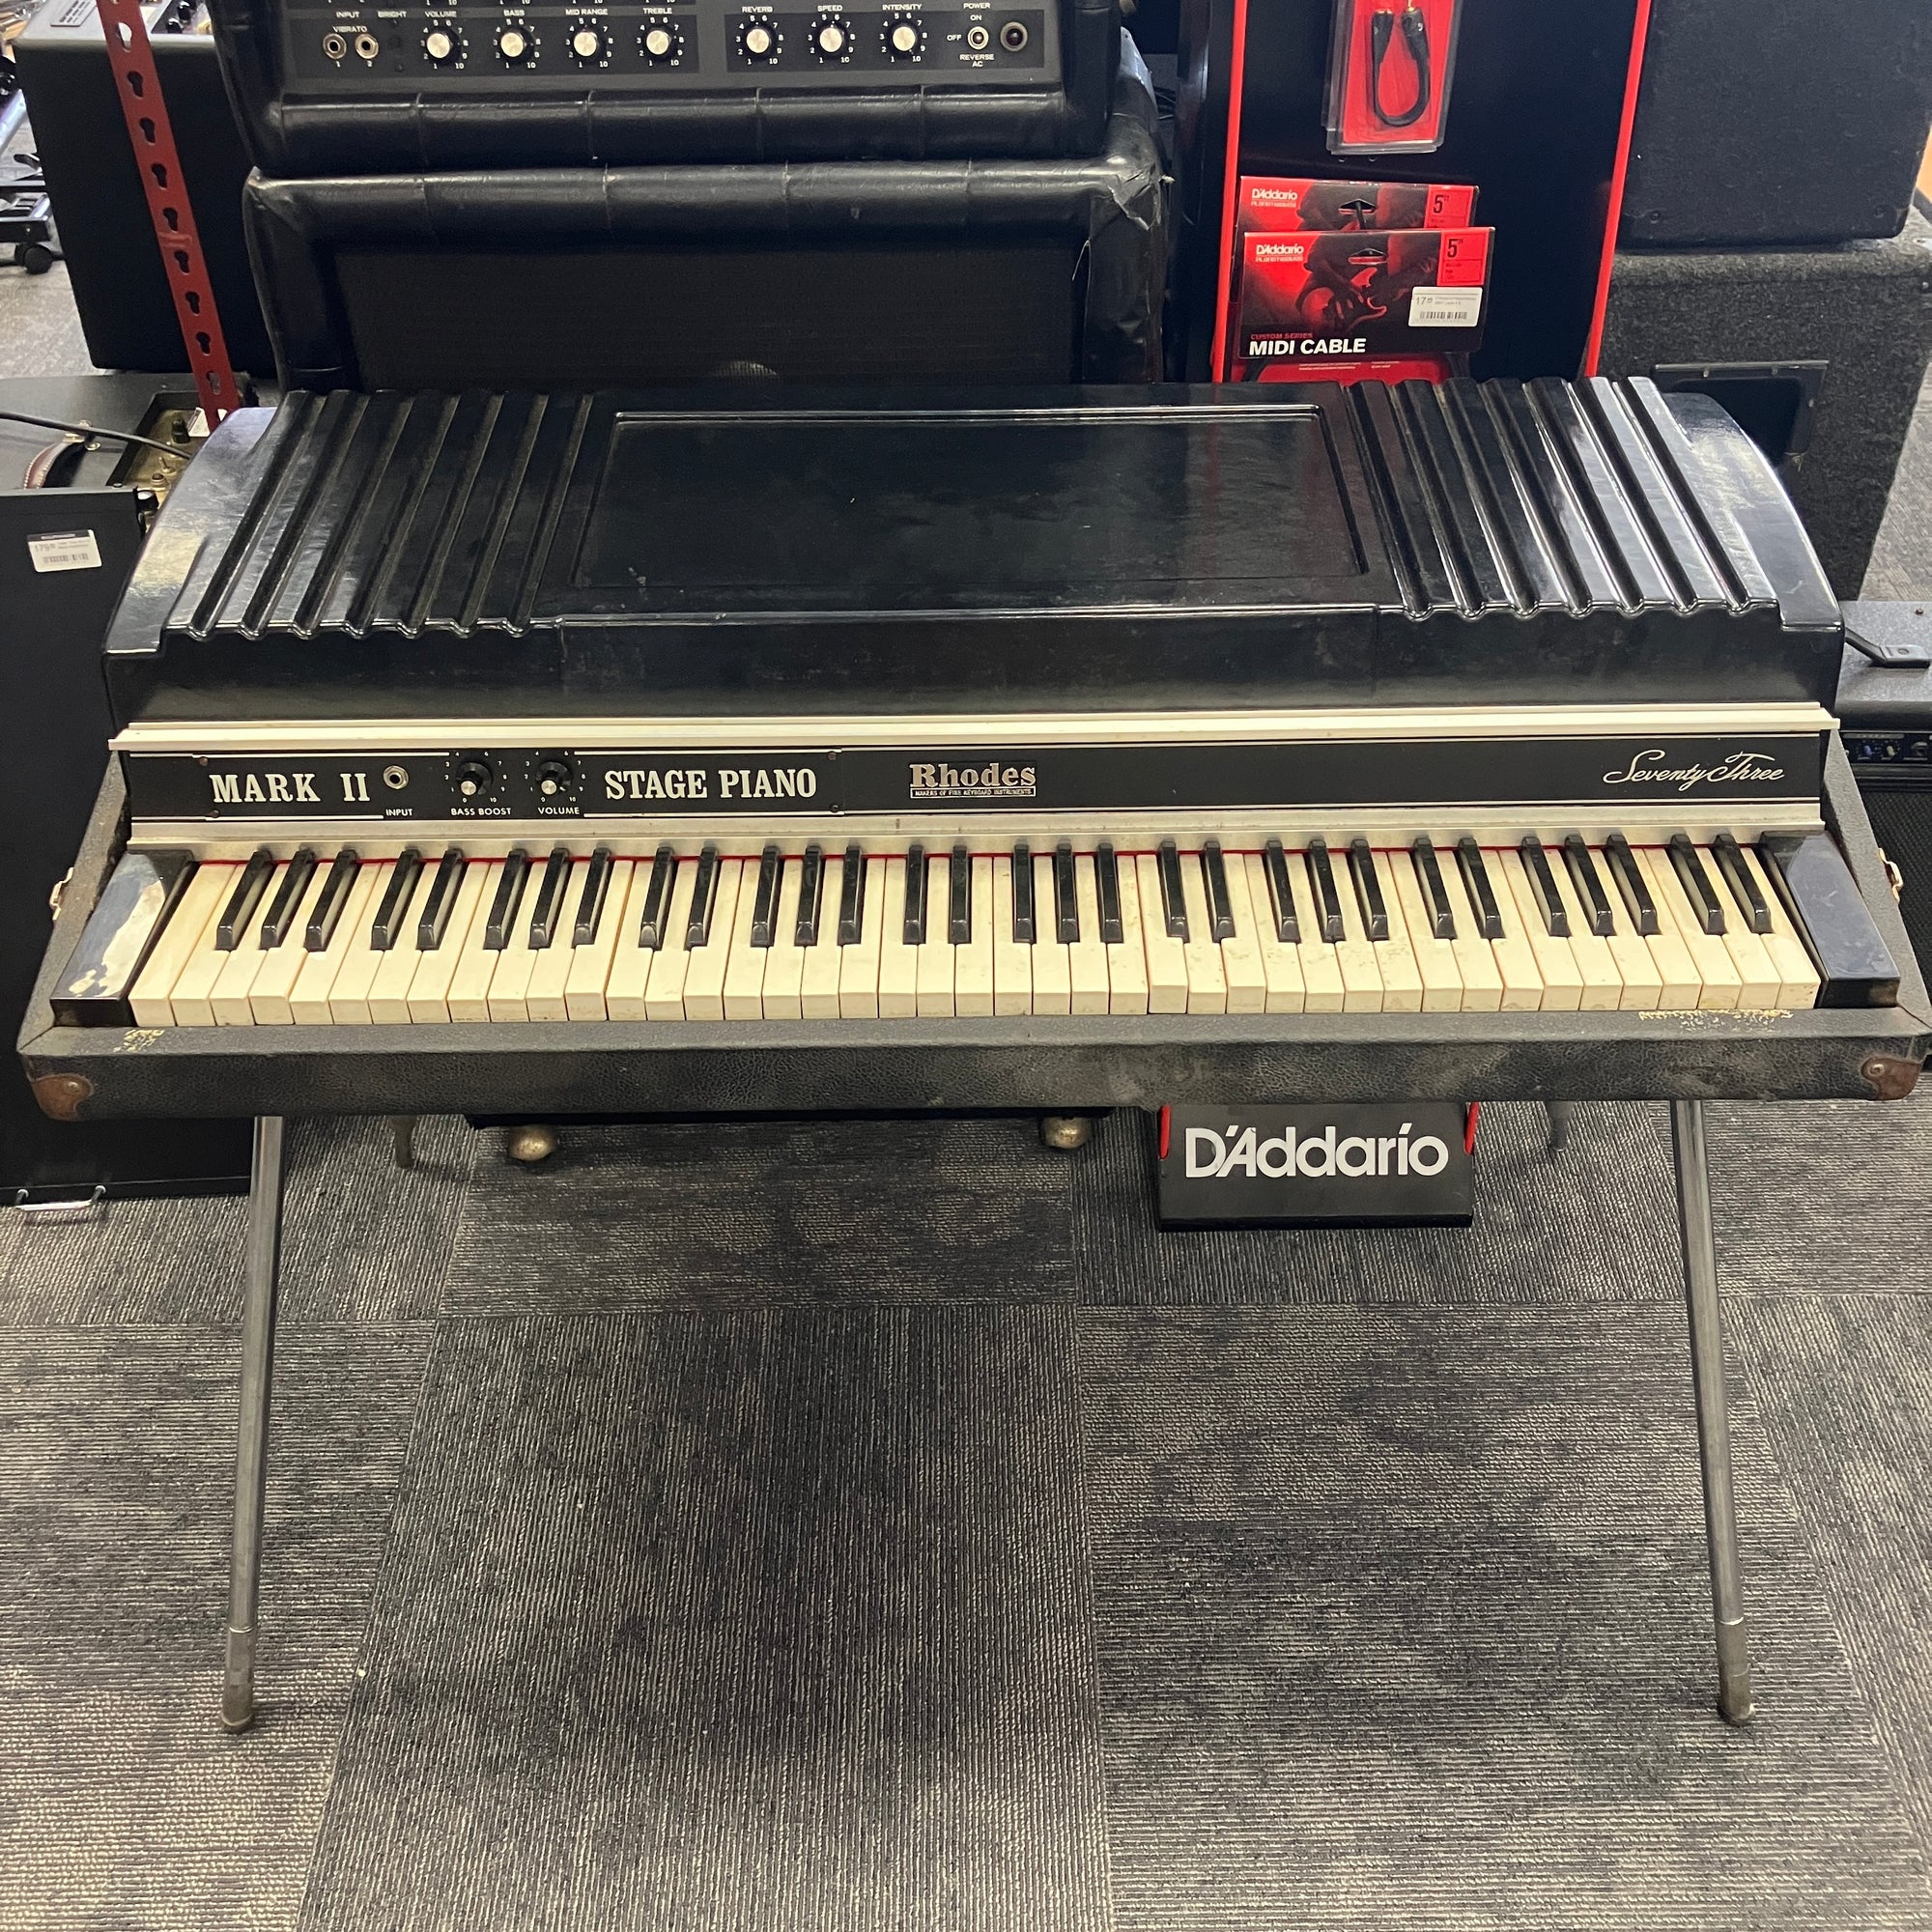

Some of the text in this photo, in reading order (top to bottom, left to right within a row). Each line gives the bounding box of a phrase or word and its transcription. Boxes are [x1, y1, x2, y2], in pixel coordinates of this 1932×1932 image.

[1434, 194, 1444, 213] 5
[1447, 239, 1458, 257] 5
[1249, 338, 1366, 355] MIDI CABLE
[910, 763, 1036, 787] Rhodes
[1603, 750, 1785, 791] Seventy Three
[209, 774, 370, 803] MARK II
[604, 768, 816, 800] STAGE PIANO
[1185, 1122, 1449, 1179] D'Addario
